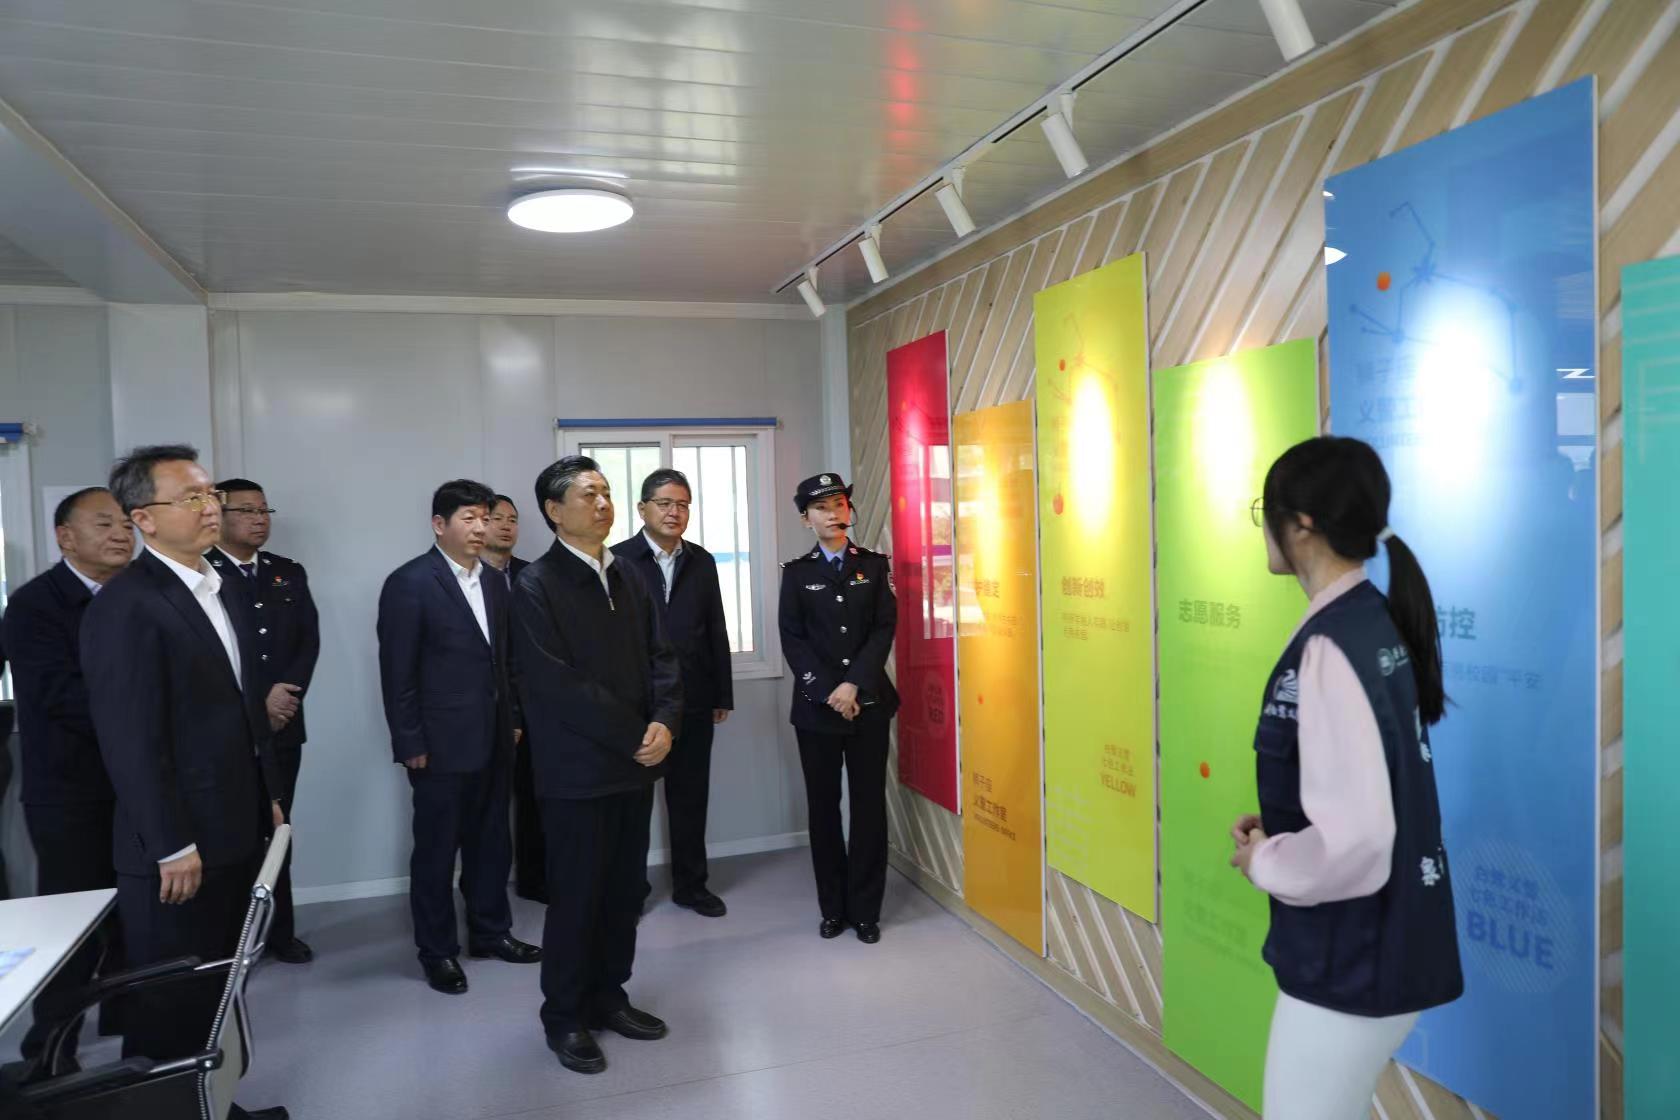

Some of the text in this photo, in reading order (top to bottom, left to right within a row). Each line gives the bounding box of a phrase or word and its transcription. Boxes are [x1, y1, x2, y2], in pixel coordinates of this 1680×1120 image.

[1178, 598, 1241, 629] 志愿服务
[1100, 773, 1137, 798] YELLOW
[1466, 911, 1553, 970] BLUE
